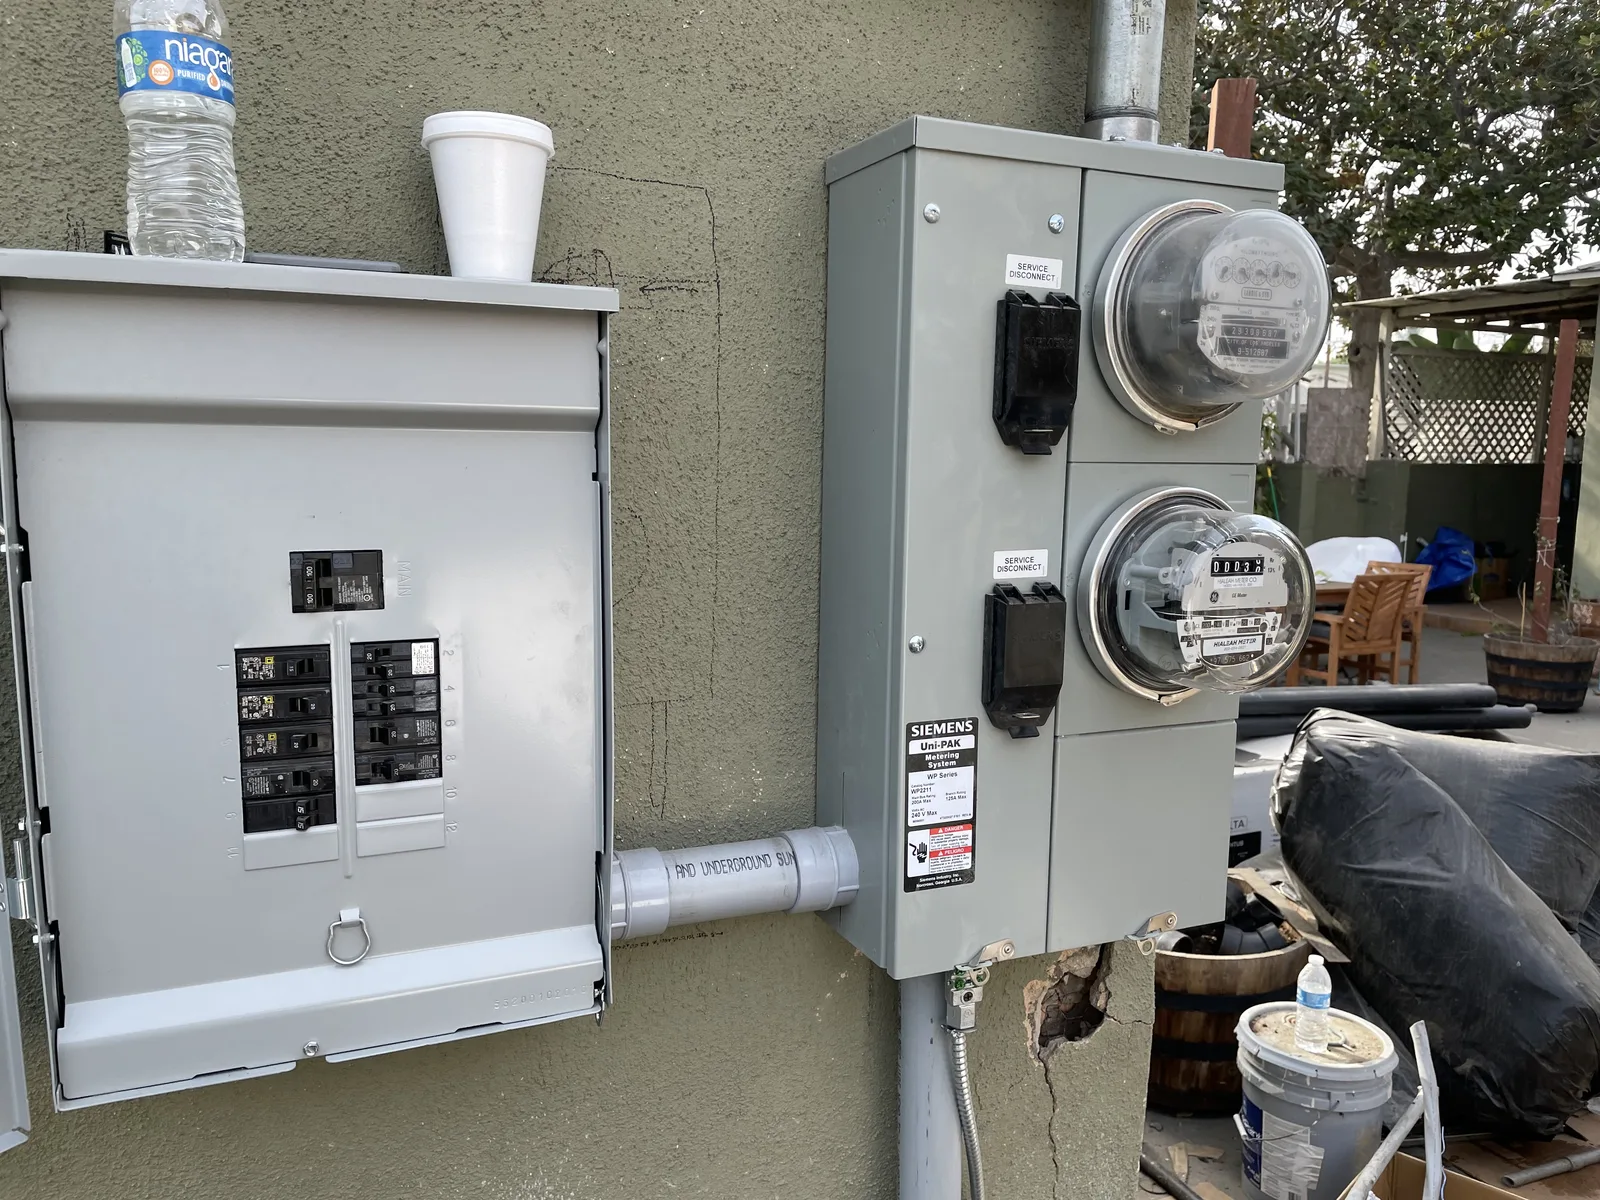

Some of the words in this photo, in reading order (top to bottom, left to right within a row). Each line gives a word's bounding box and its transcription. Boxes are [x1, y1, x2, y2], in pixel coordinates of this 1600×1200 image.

[164, 37, 233, 89] niagar
[177, 69, 206, 81] PURIFIED
[1017, 262, 1048, 273] SERVICE
[1009, 270, 1056, 282] DISCONNECT
[1004, 556, 1034, 565] SERVICE
[997, 563, 1042, 573] DISCONNECT
[397, 560, 411, 597] MAIN
[306, 593, 314, 604] 100
[366, 652, 373, 660] 20
[389, 685, 395, 693] 20
[390, 703, 396, 711] 20
[444, 719, 457, 728] 6
[911, 720, 974, 737] SIEMENS
[391, 730, 397, 738] 20
[925, 752, 960, 761] Metering
[928, 761, 957, 769] System
[394, 768, 399, 776] 20
[312, 779, 319, 787] 20
[445, 786, 458, 799] 10
[446, 820, 458, 832] 12
[675, 862, 697, 879] AND
[700, 853, 772, 877] UNDERGROUND
